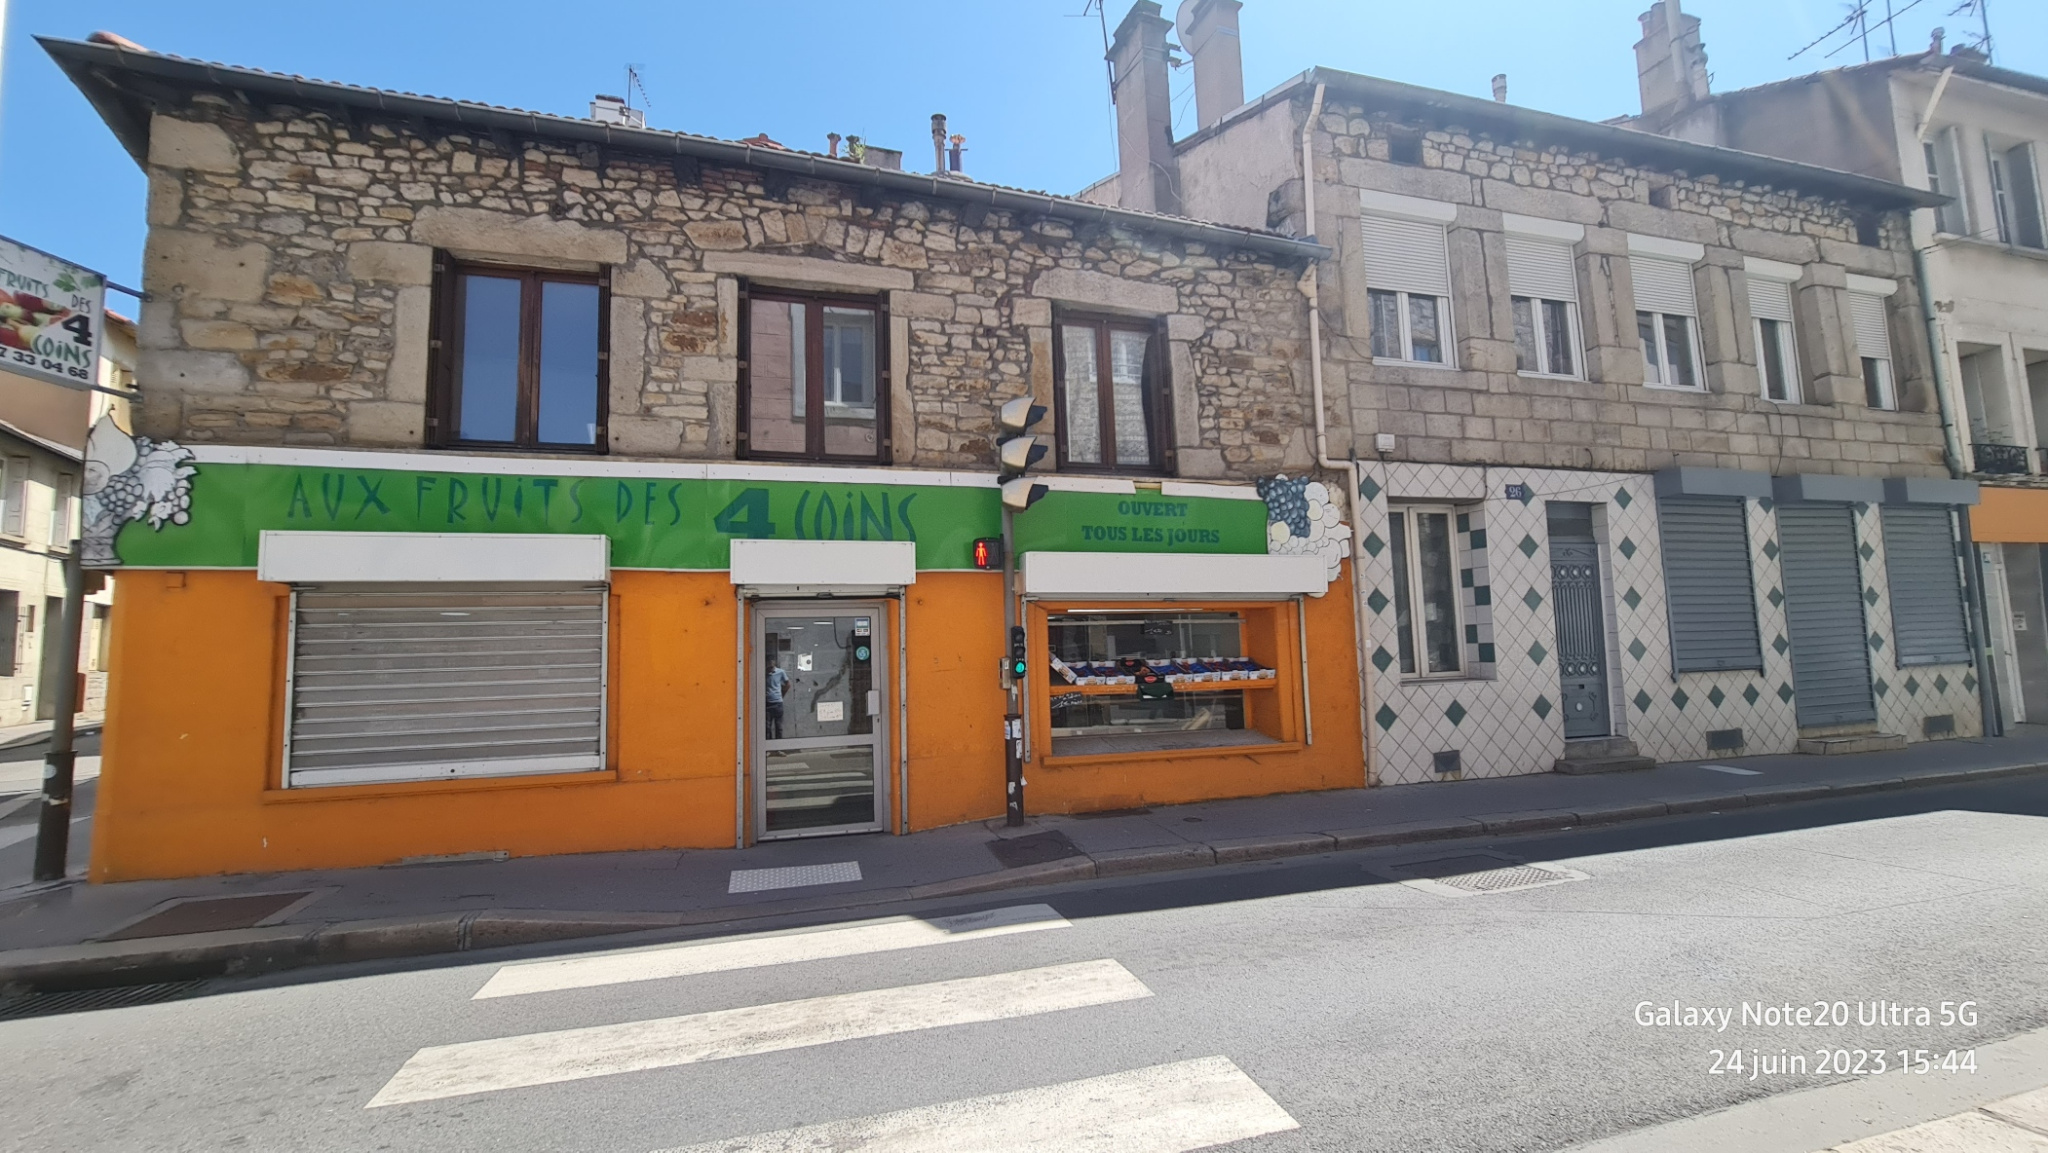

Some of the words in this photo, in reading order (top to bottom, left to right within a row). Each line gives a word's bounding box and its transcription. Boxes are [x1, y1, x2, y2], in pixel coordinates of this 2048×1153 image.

[71, 294, 91, 313] DES
[62, 314, 93, 347] 4
[13, 351, 36, 365] 33
[41, 359, 63, 373] 04
[68, 366, 88, 379] 68
[1508, 486, 1522, 497] 26
[287, 473, 391, 522] AUX
[616, 480, 682, 525] DES
[713, 487, 776, 540] 4
[1118, 501, 1188, 516] OUVERT
[1082, 525, 1127, 540] TOUS
[1131, 527, 1163, 542] LES
[1167, 528, 1220, 546] JOURS
